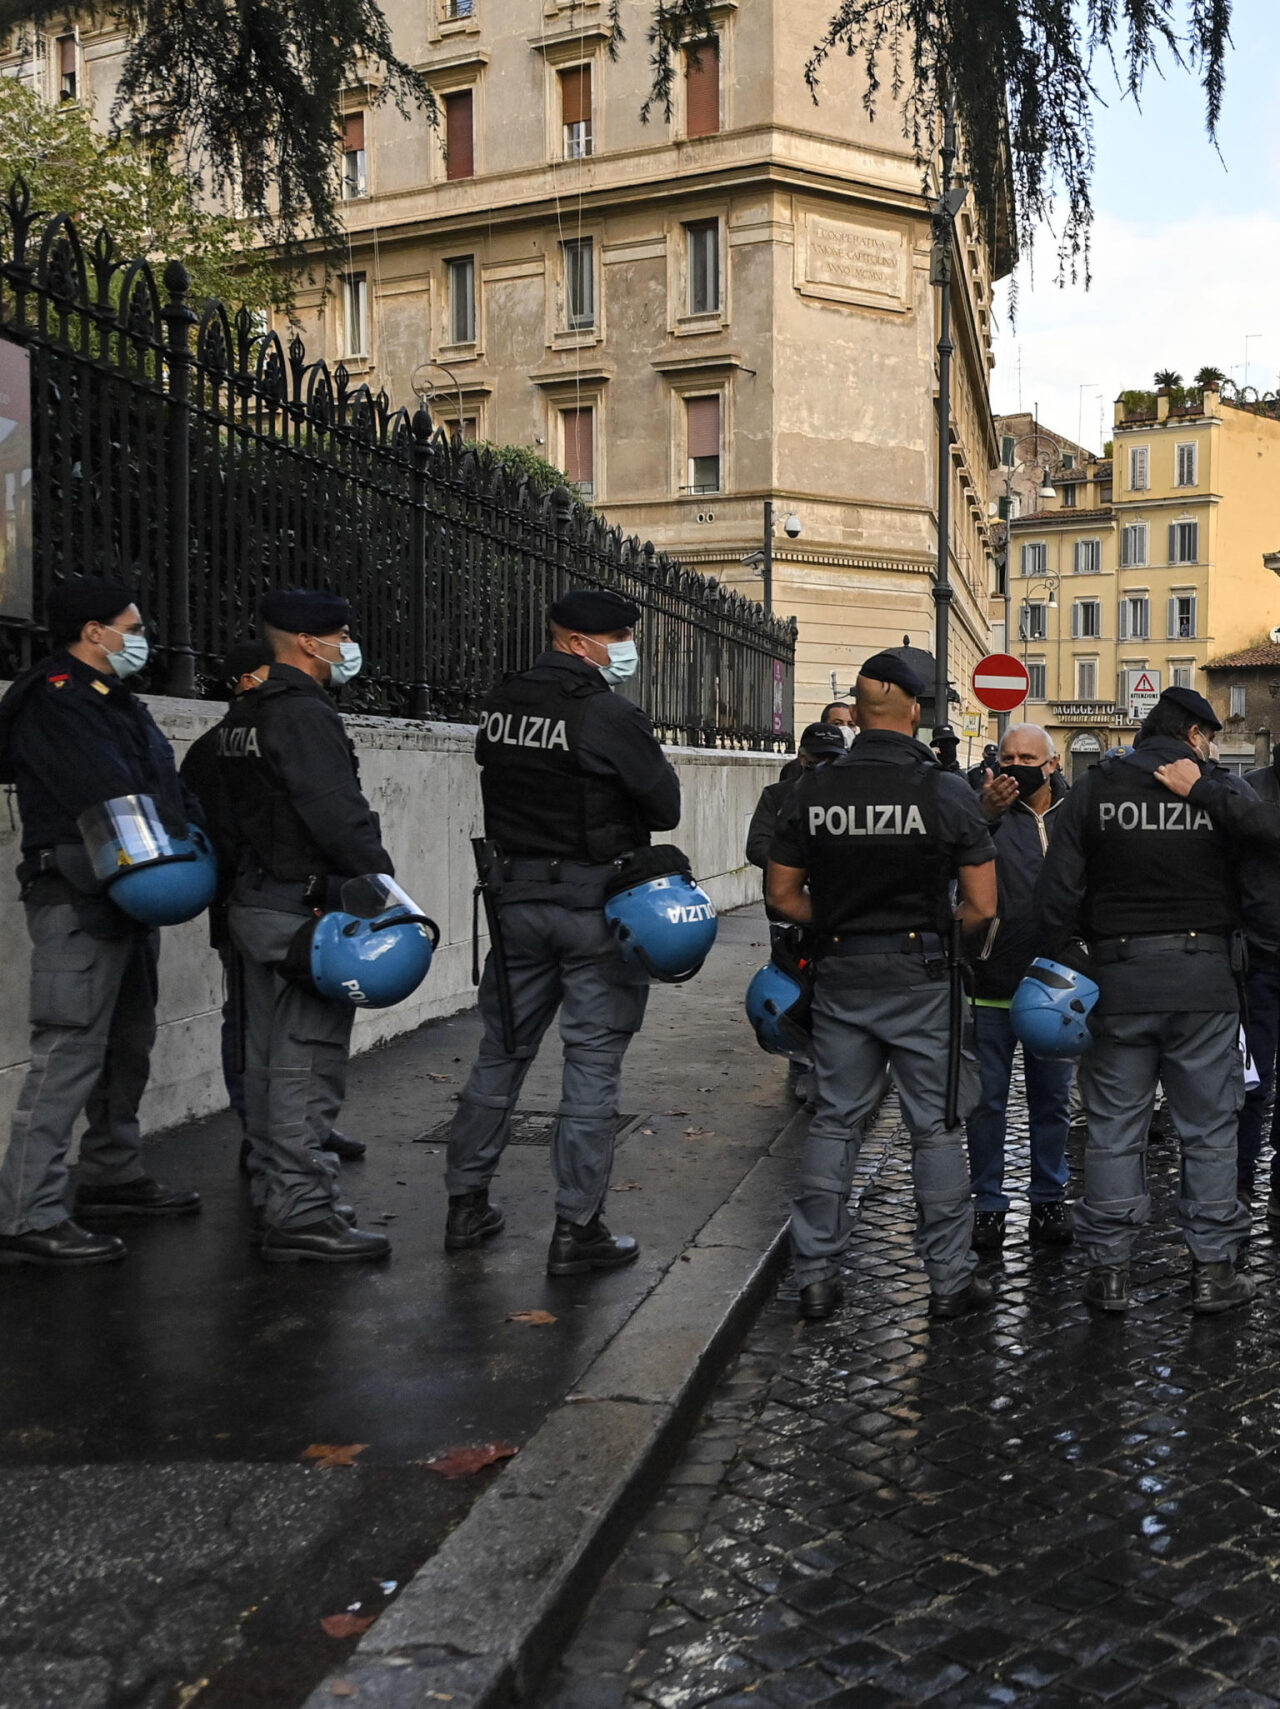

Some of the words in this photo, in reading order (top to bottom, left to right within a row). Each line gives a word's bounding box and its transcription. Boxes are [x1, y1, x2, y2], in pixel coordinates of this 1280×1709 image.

[480, 711, 570, 751] POLIZIA
[808, 805, 927, 836] POLIZIA
[1099, 801, 1214, 831] POLIZIA
